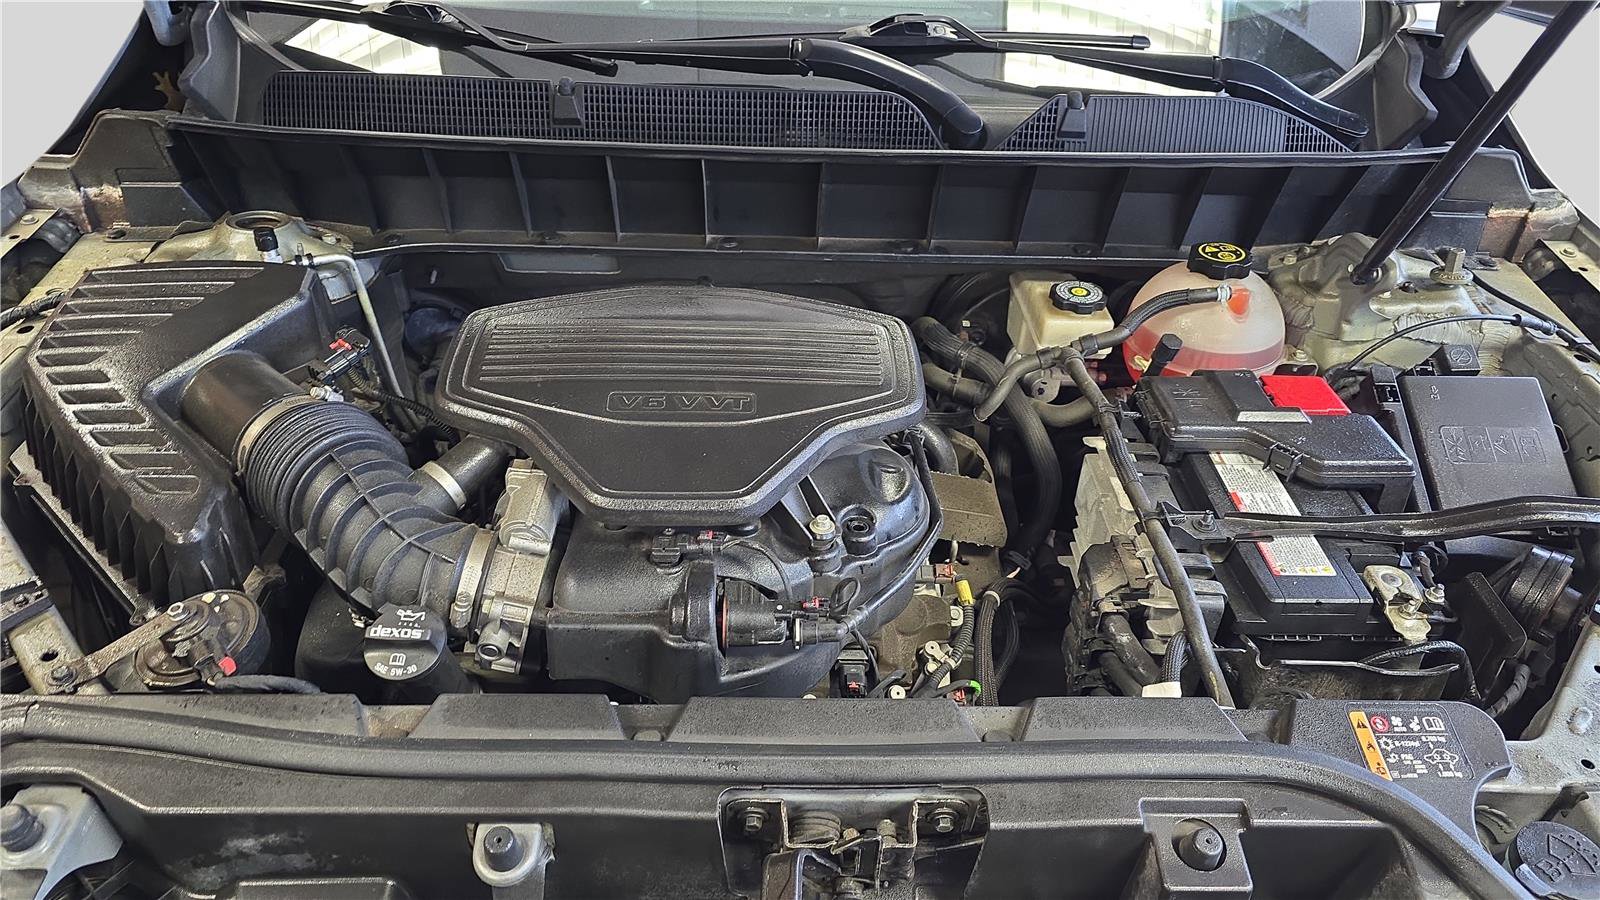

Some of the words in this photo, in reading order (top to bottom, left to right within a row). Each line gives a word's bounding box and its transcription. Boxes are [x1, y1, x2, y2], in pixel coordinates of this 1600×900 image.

[614, 395, 666, 409] V6
[674, 395, 750, 411] VVT
[370, 625, 423, 639] dexos
[374, 662, 388, 674] SAE
[390, 664, 418, 676] 5W-30
